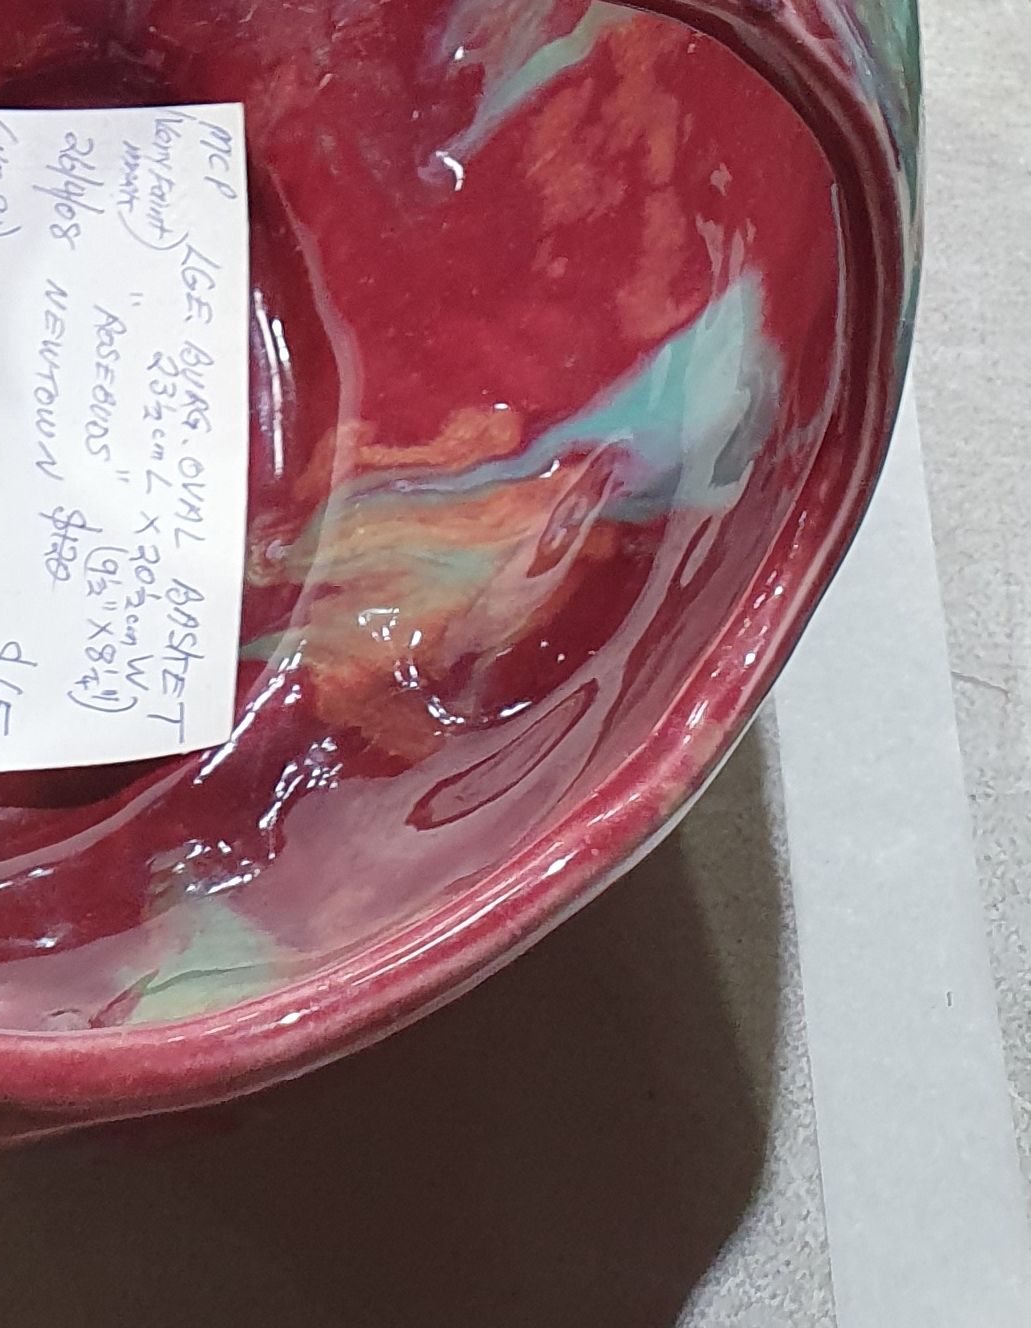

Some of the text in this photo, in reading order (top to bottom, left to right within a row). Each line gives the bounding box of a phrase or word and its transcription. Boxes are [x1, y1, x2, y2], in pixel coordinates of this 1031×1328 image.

[33, 132, 104, 250] 26/4/08
[198, 120, 238, 200] MCP
[33, 277, 69, 481] NEWTOWN
[174, 456, 206, 548] OVAL
[147, 578, 205, 744] BASKET
